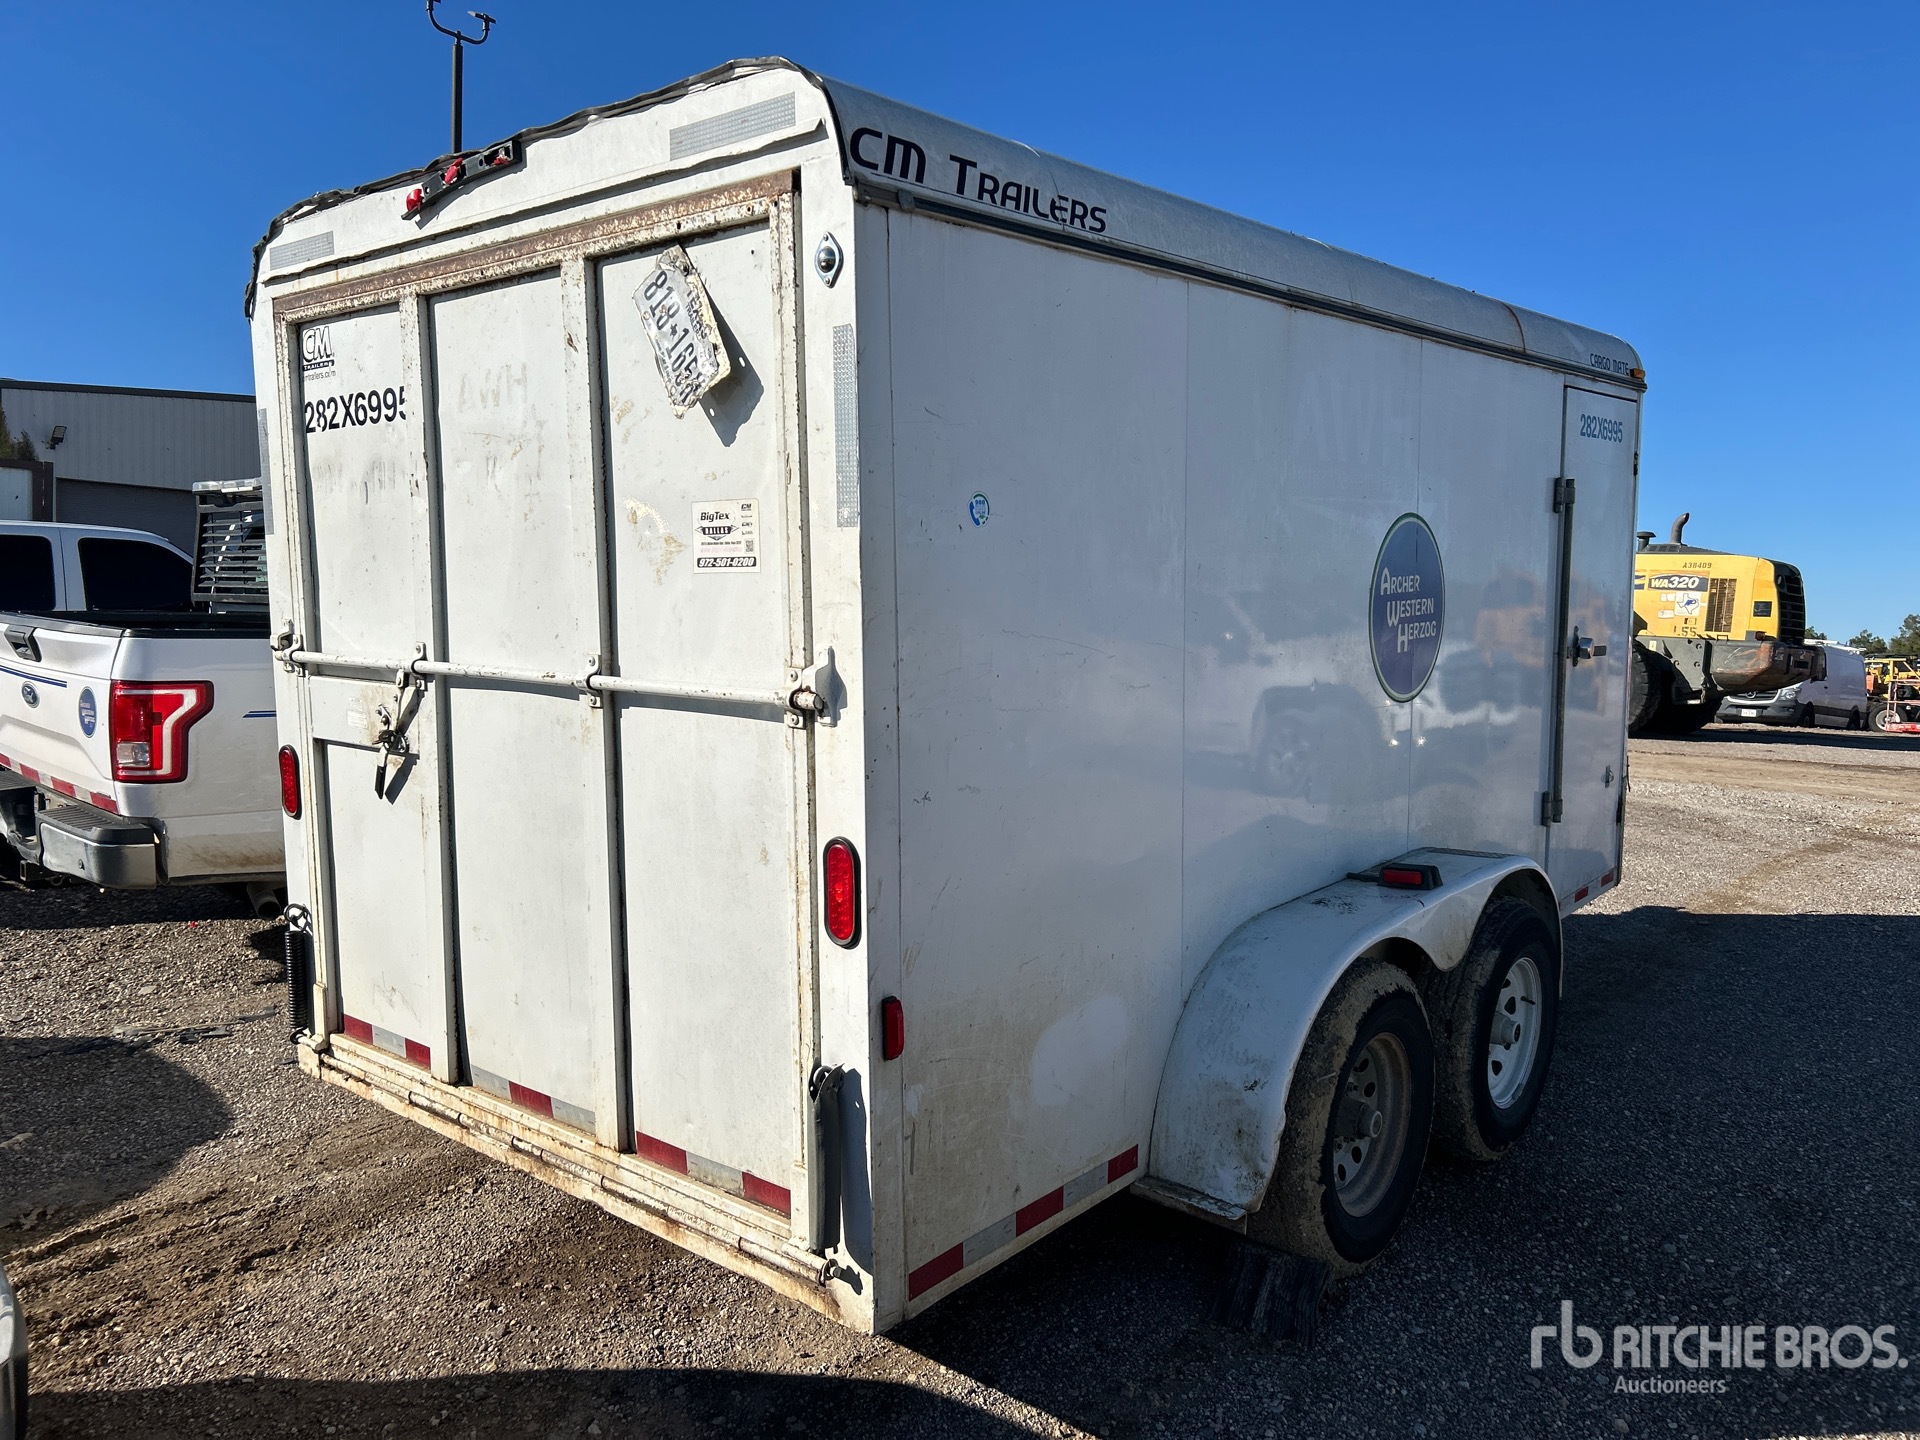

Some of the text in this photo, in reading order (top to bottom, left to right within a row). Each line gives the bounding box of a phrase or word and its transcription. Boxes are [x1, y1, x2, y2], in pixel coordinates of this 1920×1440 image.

[849, 127, 927, 184] CM
[303, 325, 333, 363] CM
[1590, 353, 1630, 376] CARGO MATE
[1580, 413, 1623, 443] 282X6995
[700, 511, 730, 523] BigTex
[699, 557, 755, 567] 972-501-0200
[1380, 567, 1420, 596] ARCHER
[1650, 576, 1700, 589] WA320
[1386, 598, 1434, 628] WESTERN
[1397, 620, 1437, 653] HERZOG
